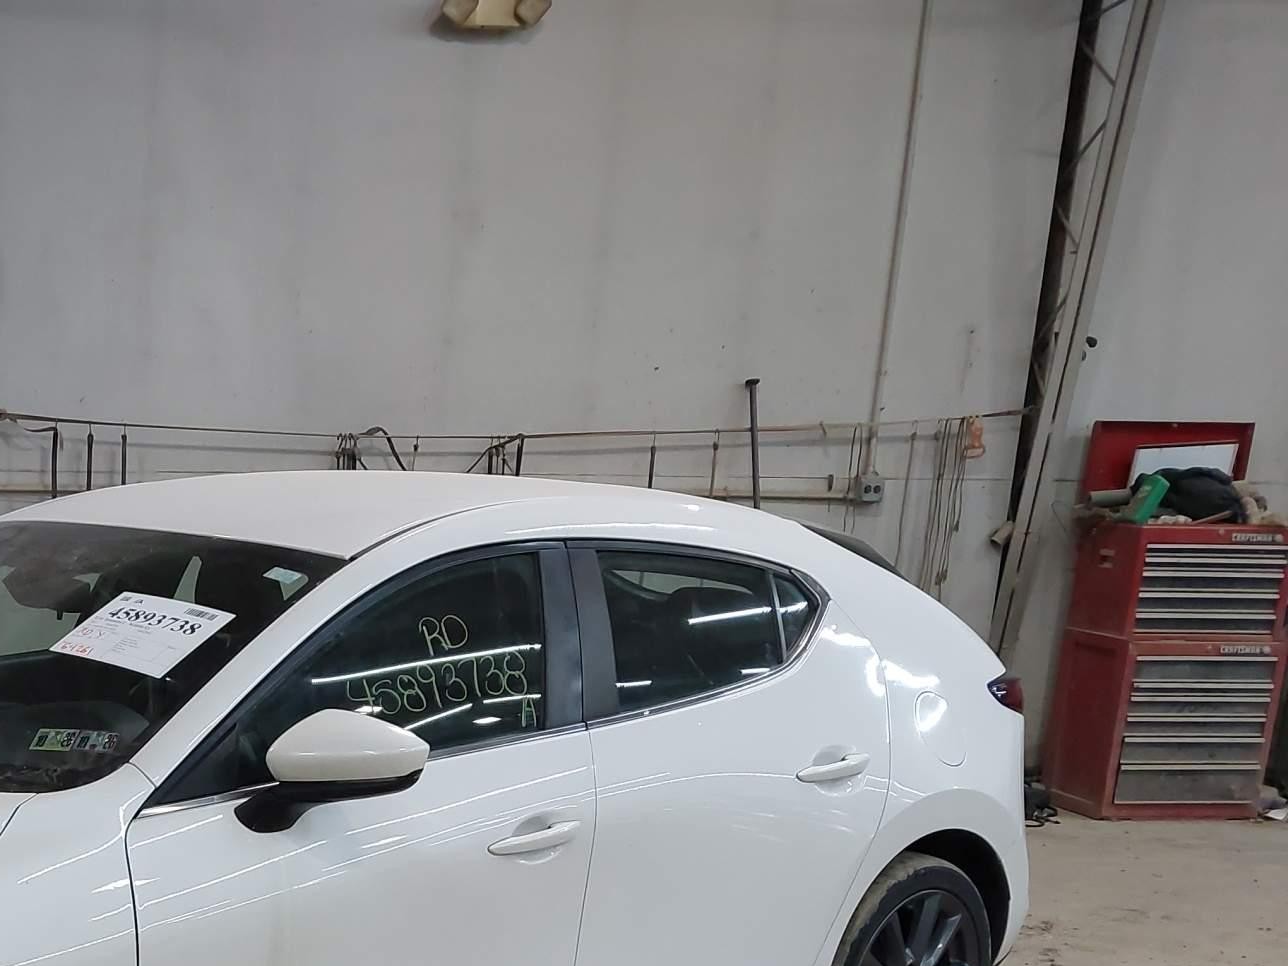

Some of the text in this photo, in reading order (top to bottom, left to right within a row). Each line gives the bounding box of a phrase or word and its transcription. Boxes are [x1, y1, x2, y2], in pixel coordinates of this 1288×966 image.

[108, 607, 202, 635] 45893738
[418, 615, 469, 657] RD
[346, 650, 528, 716] 45893738
